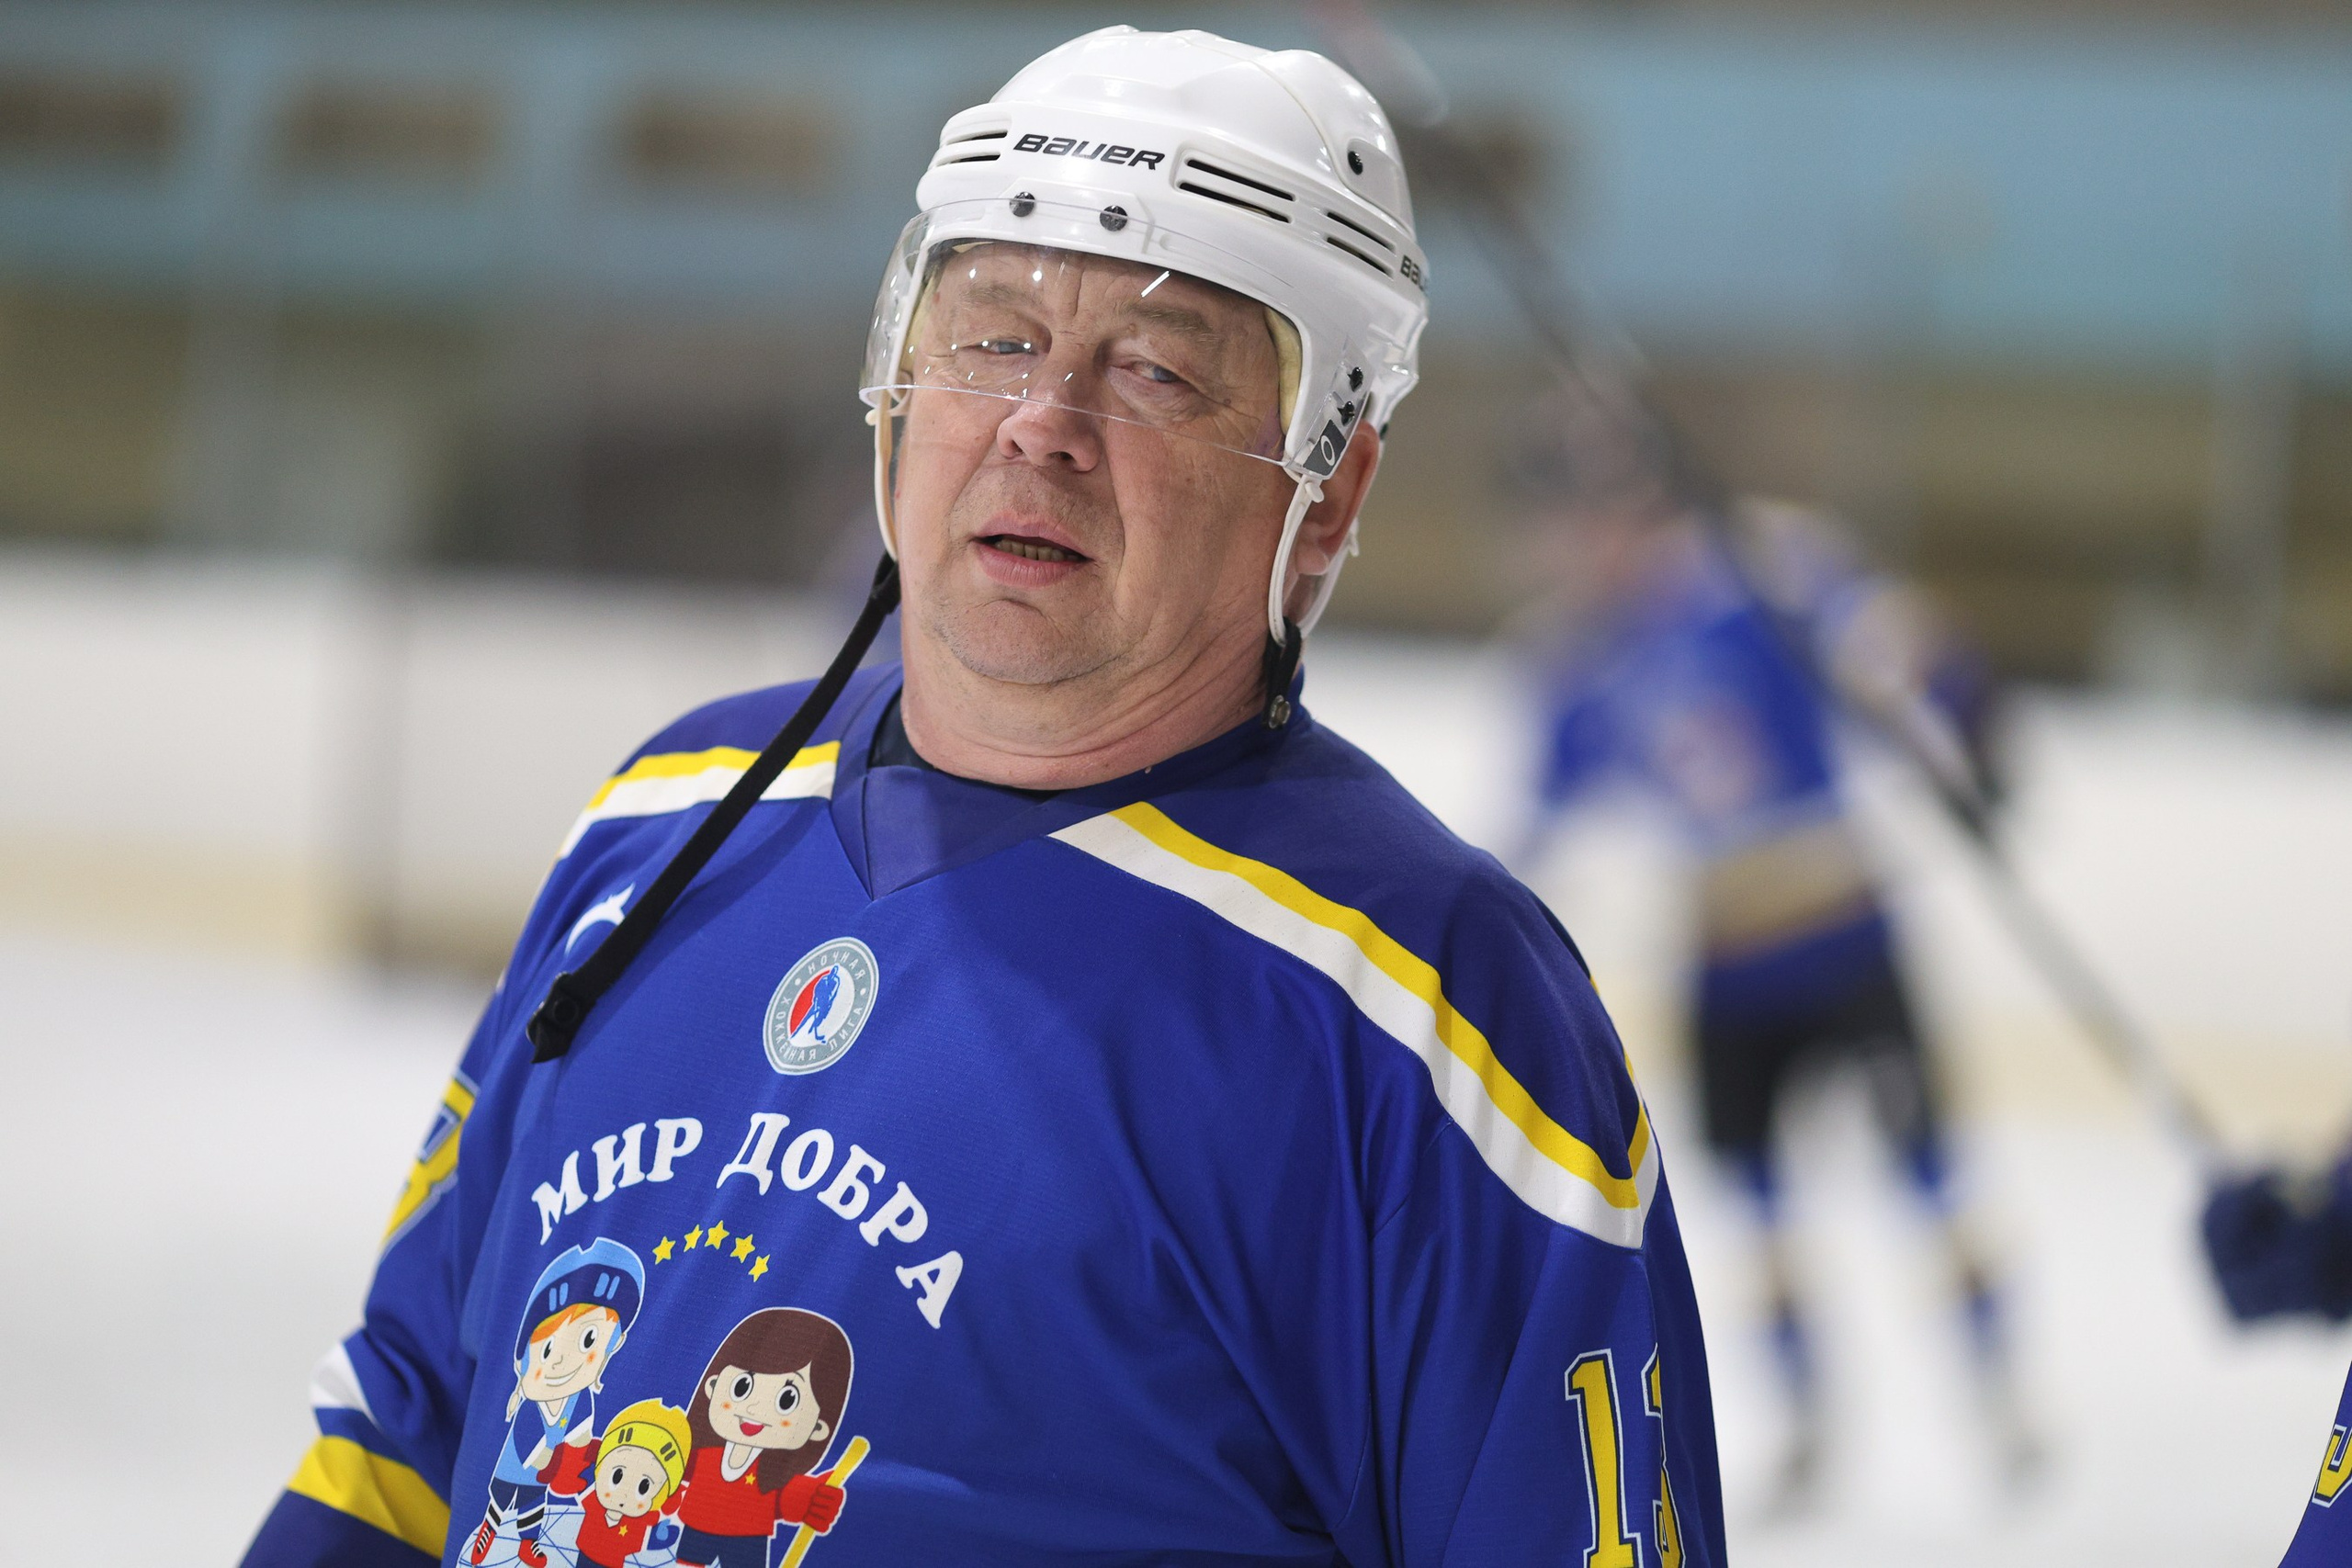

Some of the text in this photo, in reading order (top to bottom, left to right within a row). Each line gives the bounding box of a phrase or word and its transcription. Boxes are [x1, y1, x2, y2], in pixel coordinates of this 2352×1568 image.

[808, 951, 866, 980] НОЧНАЯ
[829, 1007, 864, 1052] ЛИГА
[531, 1117, 704, 1246] МИР
[716, 1111, 964, 1329] ДОБРА
